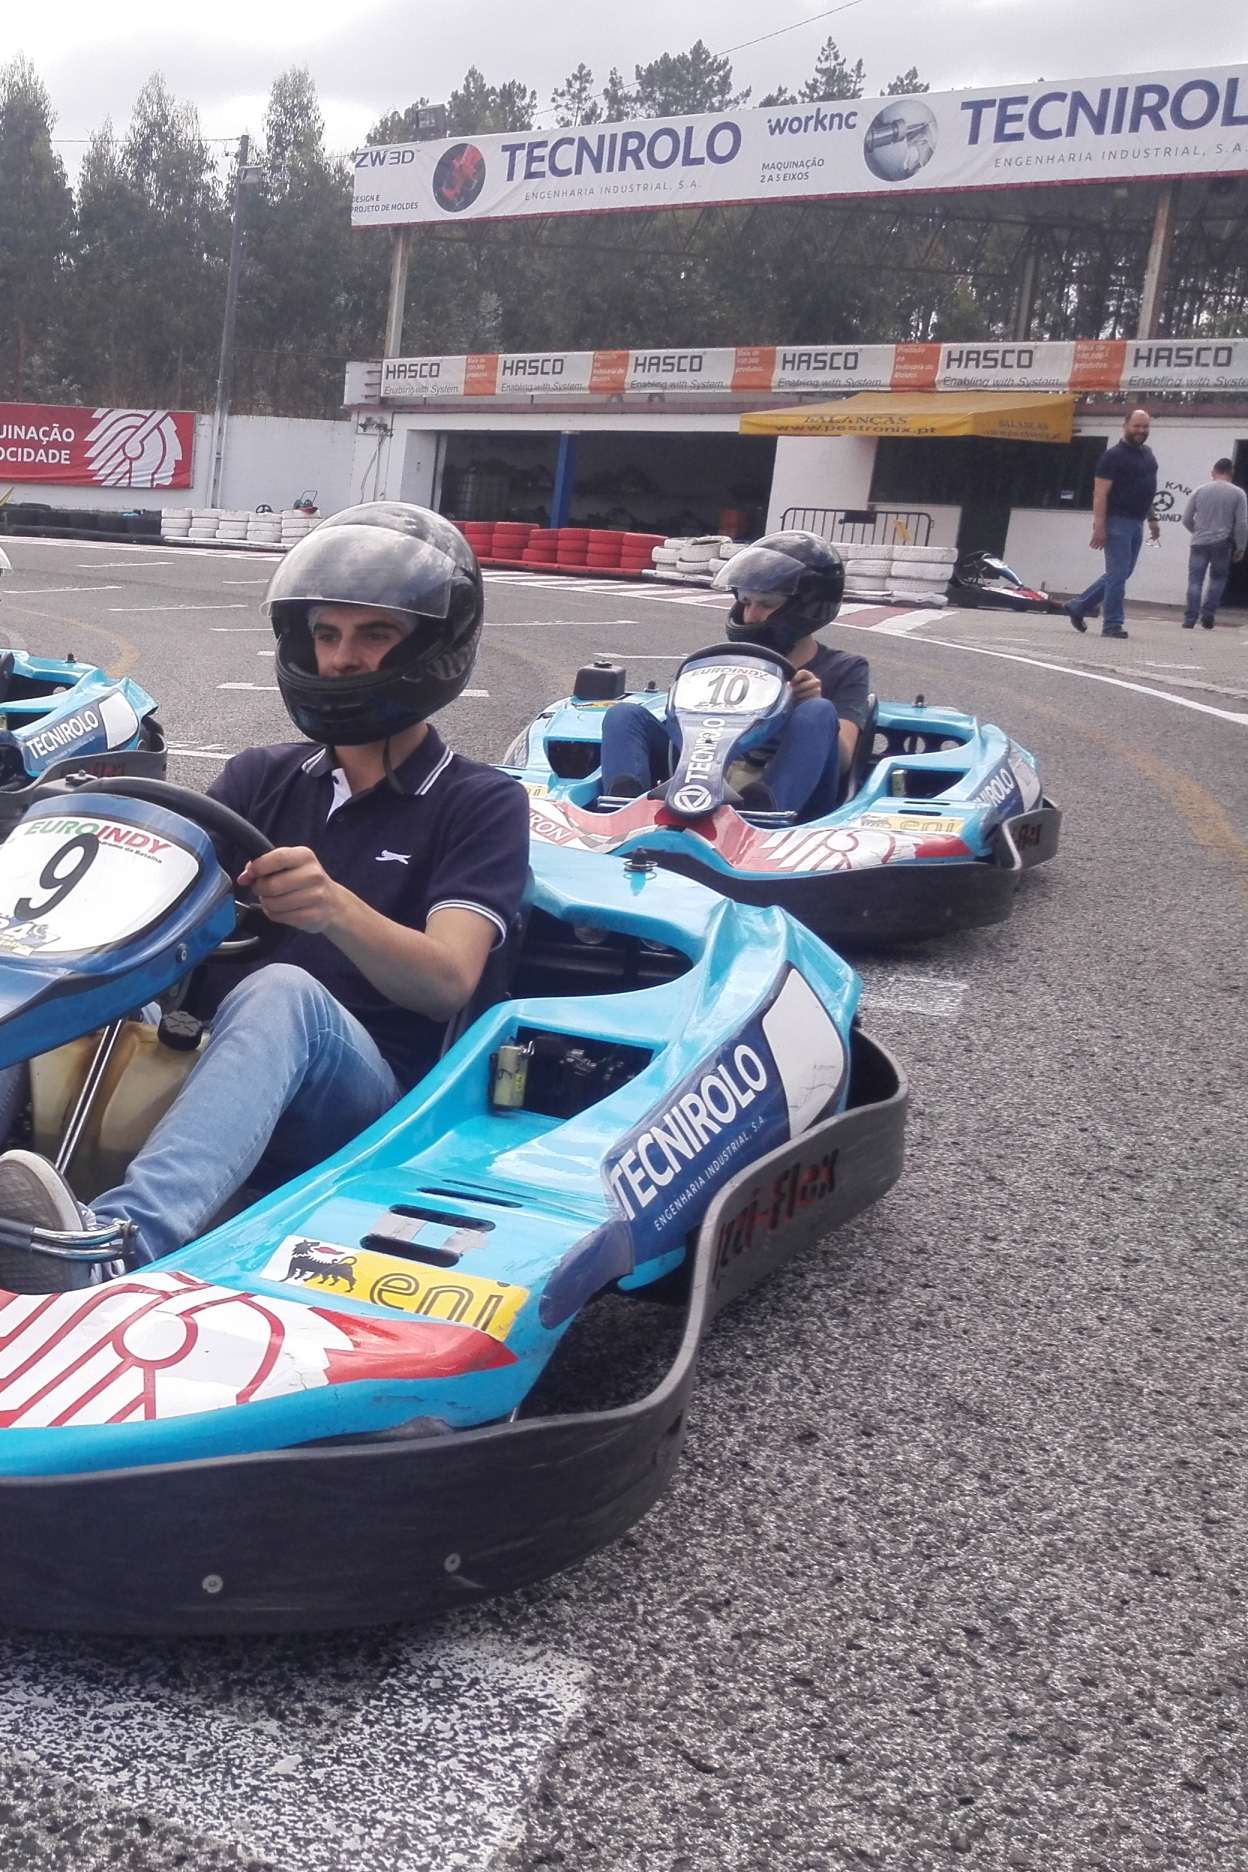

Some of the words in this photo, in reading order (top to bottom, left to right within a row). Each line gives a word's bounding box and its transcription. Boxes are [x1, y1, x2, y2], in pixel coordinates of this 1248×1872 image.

[767, 107, 858, 136] worknc
[960, 77, 1248, 145] TECNIROL
[501, 121, 742, 182] TECNIROLO
[994, 151, 1093, 169] ENGENHARIA
[1102, 145, 1207, 161] INDUSTRIAL,
[761, 157, 825, 171] MAQUINAÇÃO
[782, 171, 809, 182] EIXOS
[525, 187, 595, 201] ENGENHARIA
[600, 182, 673, 195] INDUSTRIAL,
[391, 202, 419, 210] MOLDES
[502, 358, 564, 376] HASCO
[633, 355, 702, 374] HASCO
[782, 351, 859, 371] HASCO
[946, 349, 1034, 370] HASCO
[1133, 346, 1233, 368] HASCO
[385, 362, 441, 380] HASCO
[1128, 375, 1183, 388] Enabling
[707, 673, 750, 706] 10
[26, 710, 99, 759] TECNIROLO
[900, 819, 955, 832] eni
[25, 819, 173, 855] EUROINDY
[13, 832, 100, 922] 9
[609, 1043, 768, 1222] TECNIROLO
[653, 1176, 706, 1232] ENGENHARIA
[369, 1272, 512, 1332] eni
